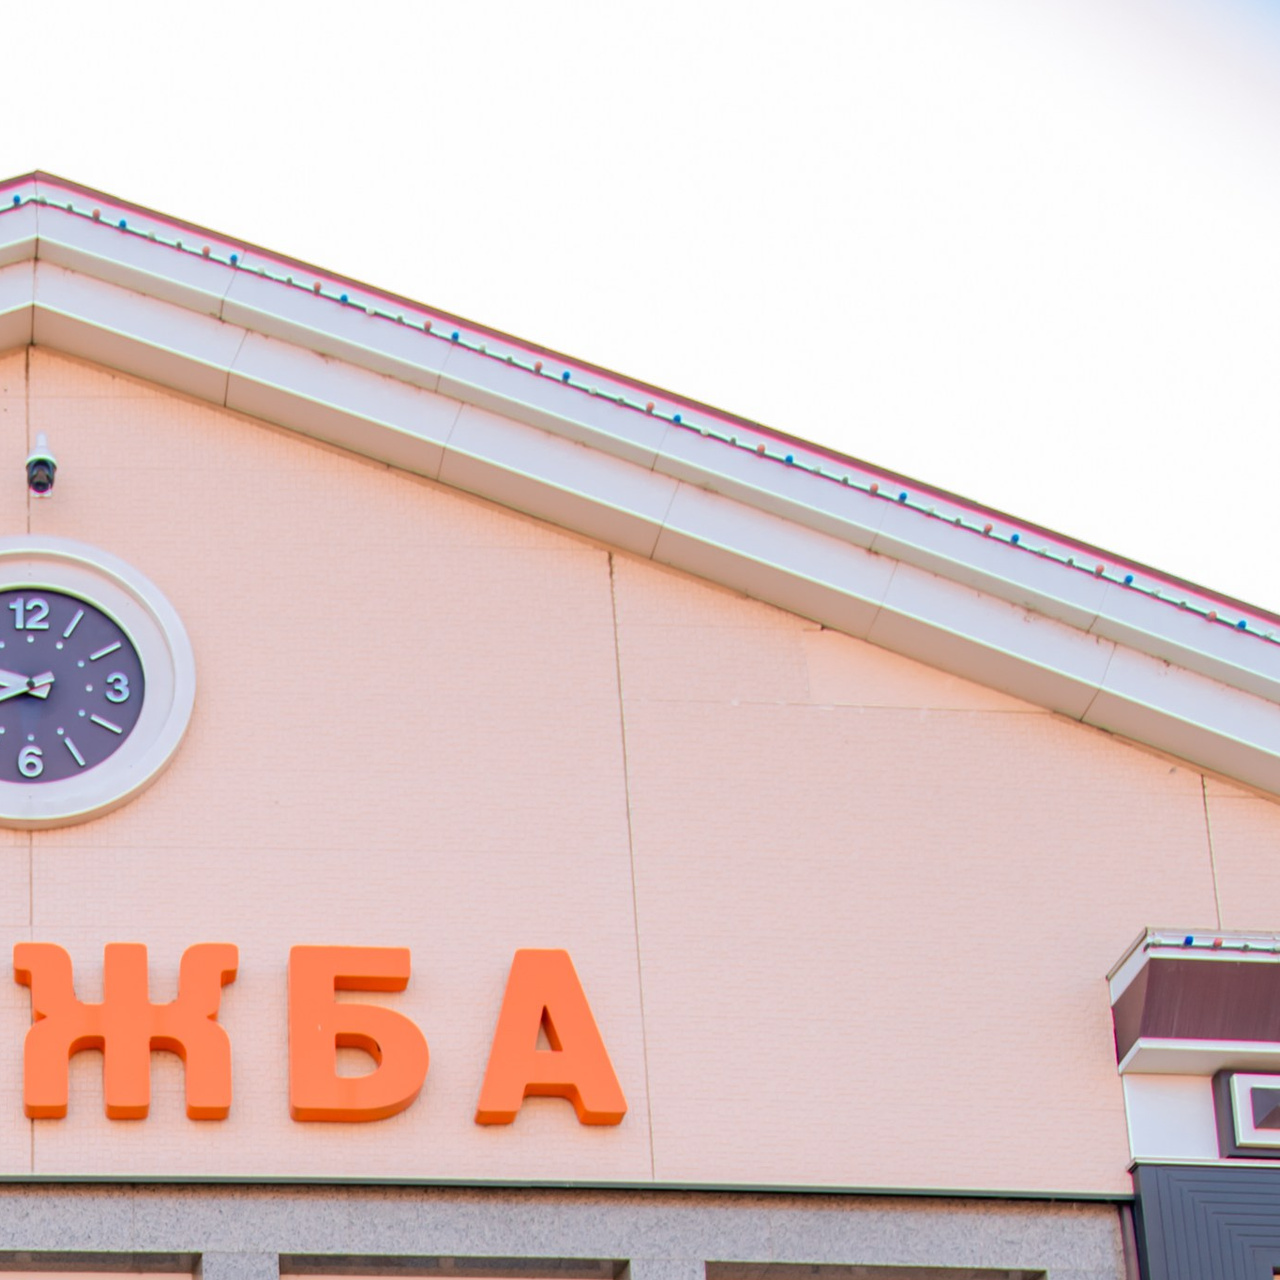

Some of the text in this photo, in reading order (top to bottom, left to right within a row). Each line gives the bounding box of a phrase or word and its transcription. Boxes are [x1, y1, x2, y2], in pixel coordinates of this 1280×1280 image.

[8, 597, 50, 630] 12
[104, 671, 131, 703] 3
[17, 745, 45, 778] 6
